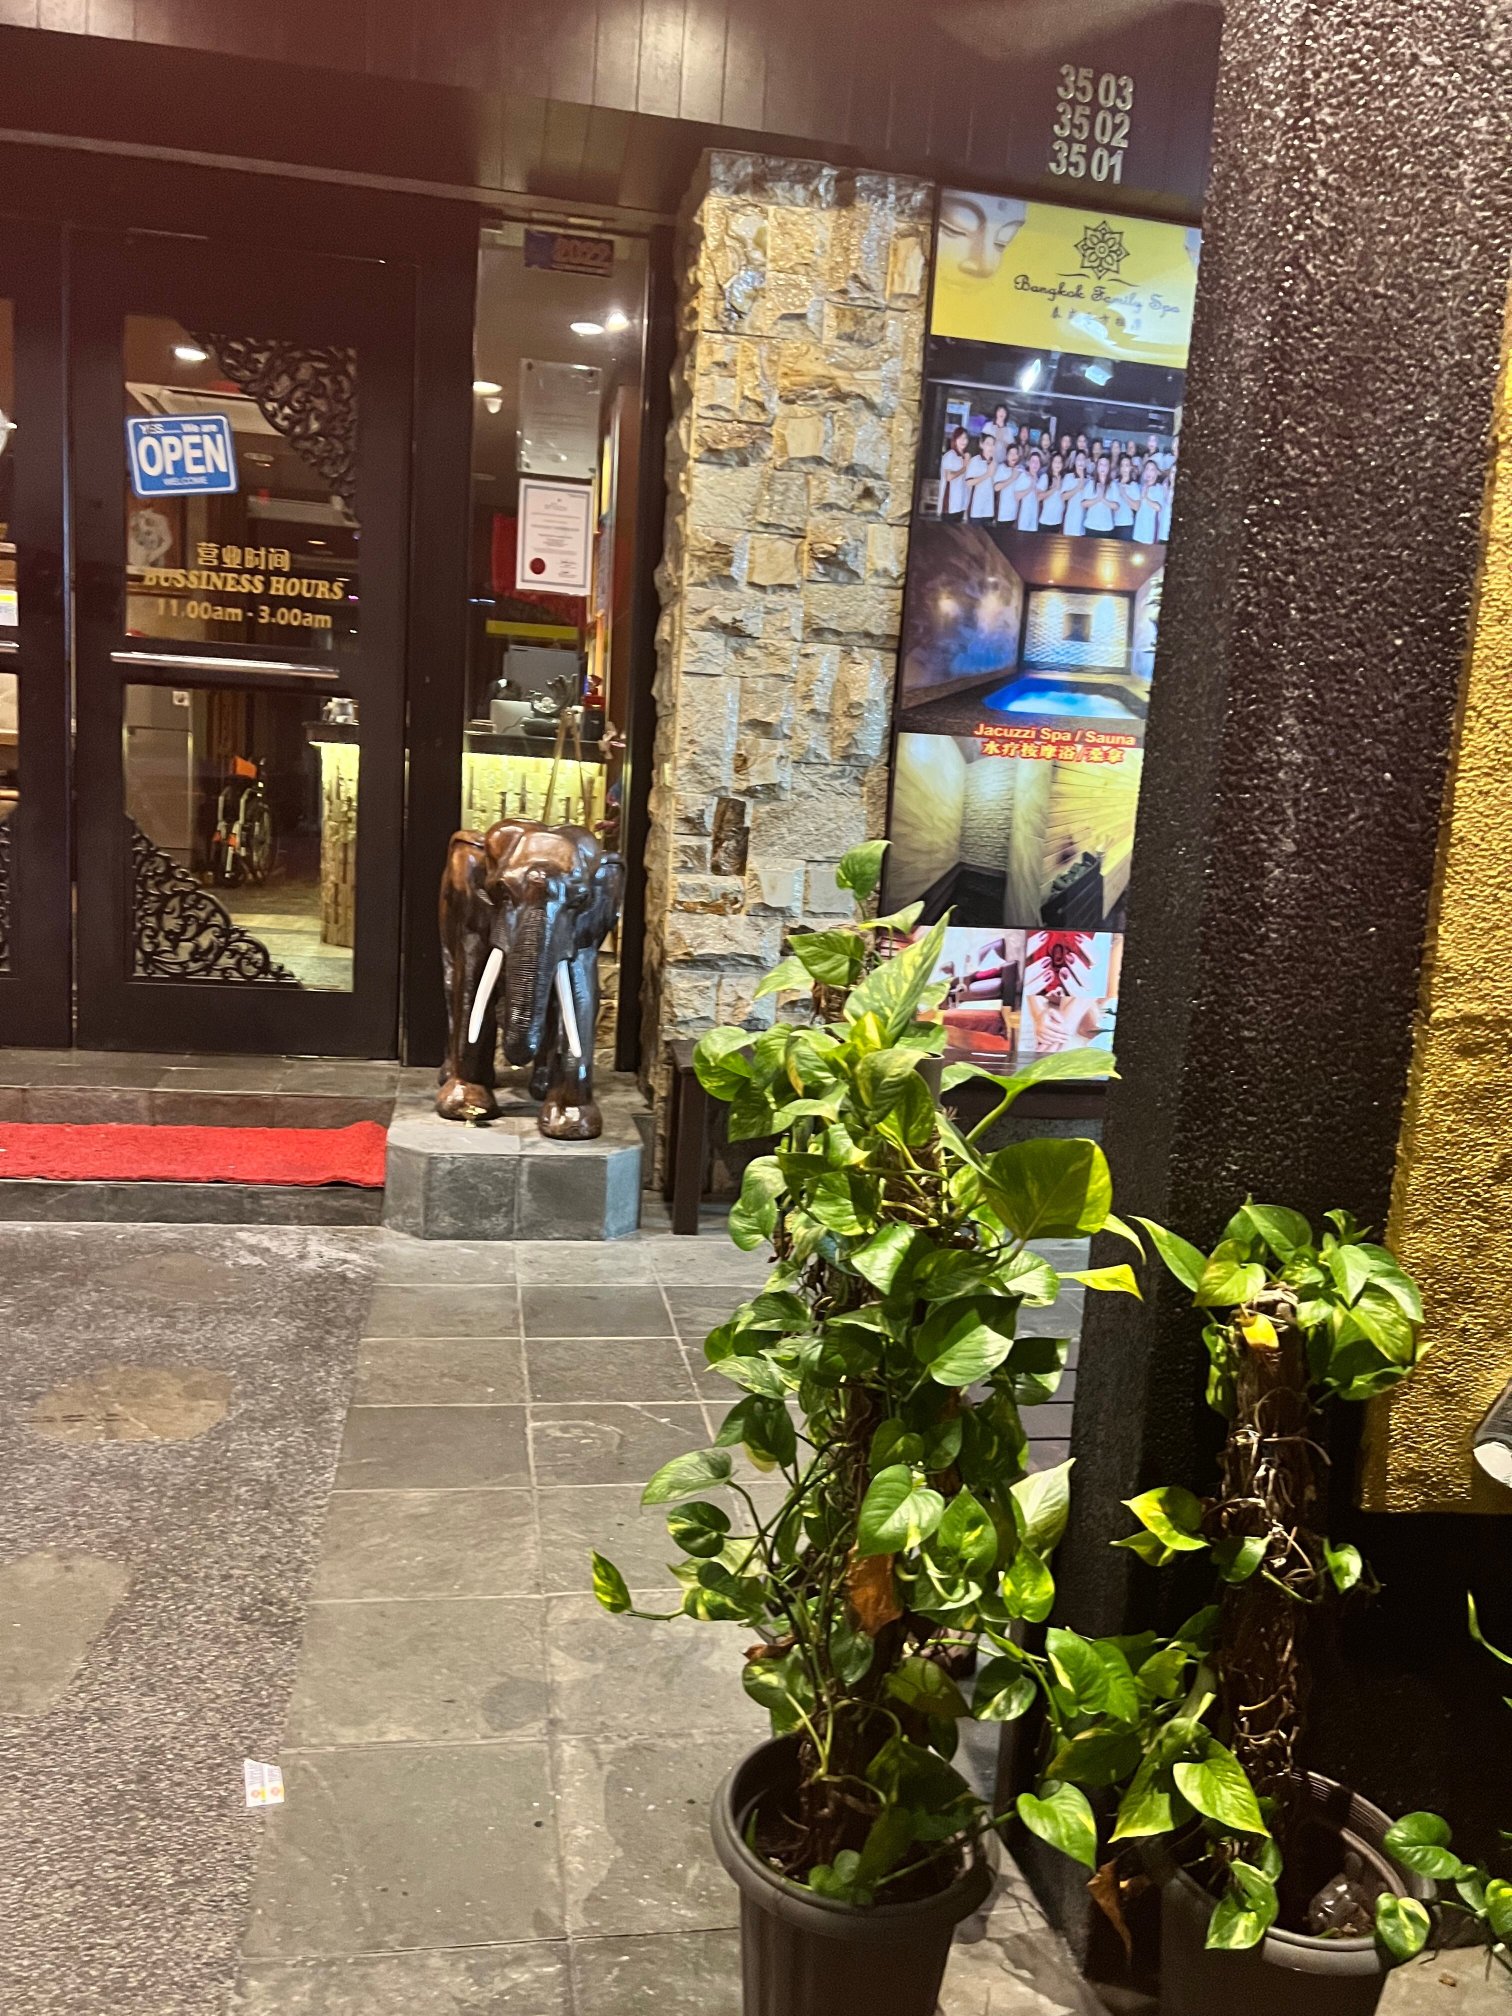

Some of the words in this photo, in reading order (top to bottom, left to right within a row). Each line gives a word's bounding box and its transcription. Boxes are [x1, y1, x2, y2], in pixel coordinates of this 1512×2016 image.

[1014, 274, 1085, 301] Bangkok
[1091, 286, 1143, 314] Family
[1150, 294, 1180, 317] Spa
[138, 433, 228, 476] OPEN
[196, 542, 291, 571] 营业时间
[142, 568, 264, 594] BUSSINESS
[268, 575, 345, 600] HOURS
[157, 598, 243, 622] 11.00am
[257, 605, 333, 628] 3.00am
[974, 723, 1037, 739] Jacuzzi
[1040, 727, 1072, 743] Spa
[1085, 730, 1136, 746] Sauna
